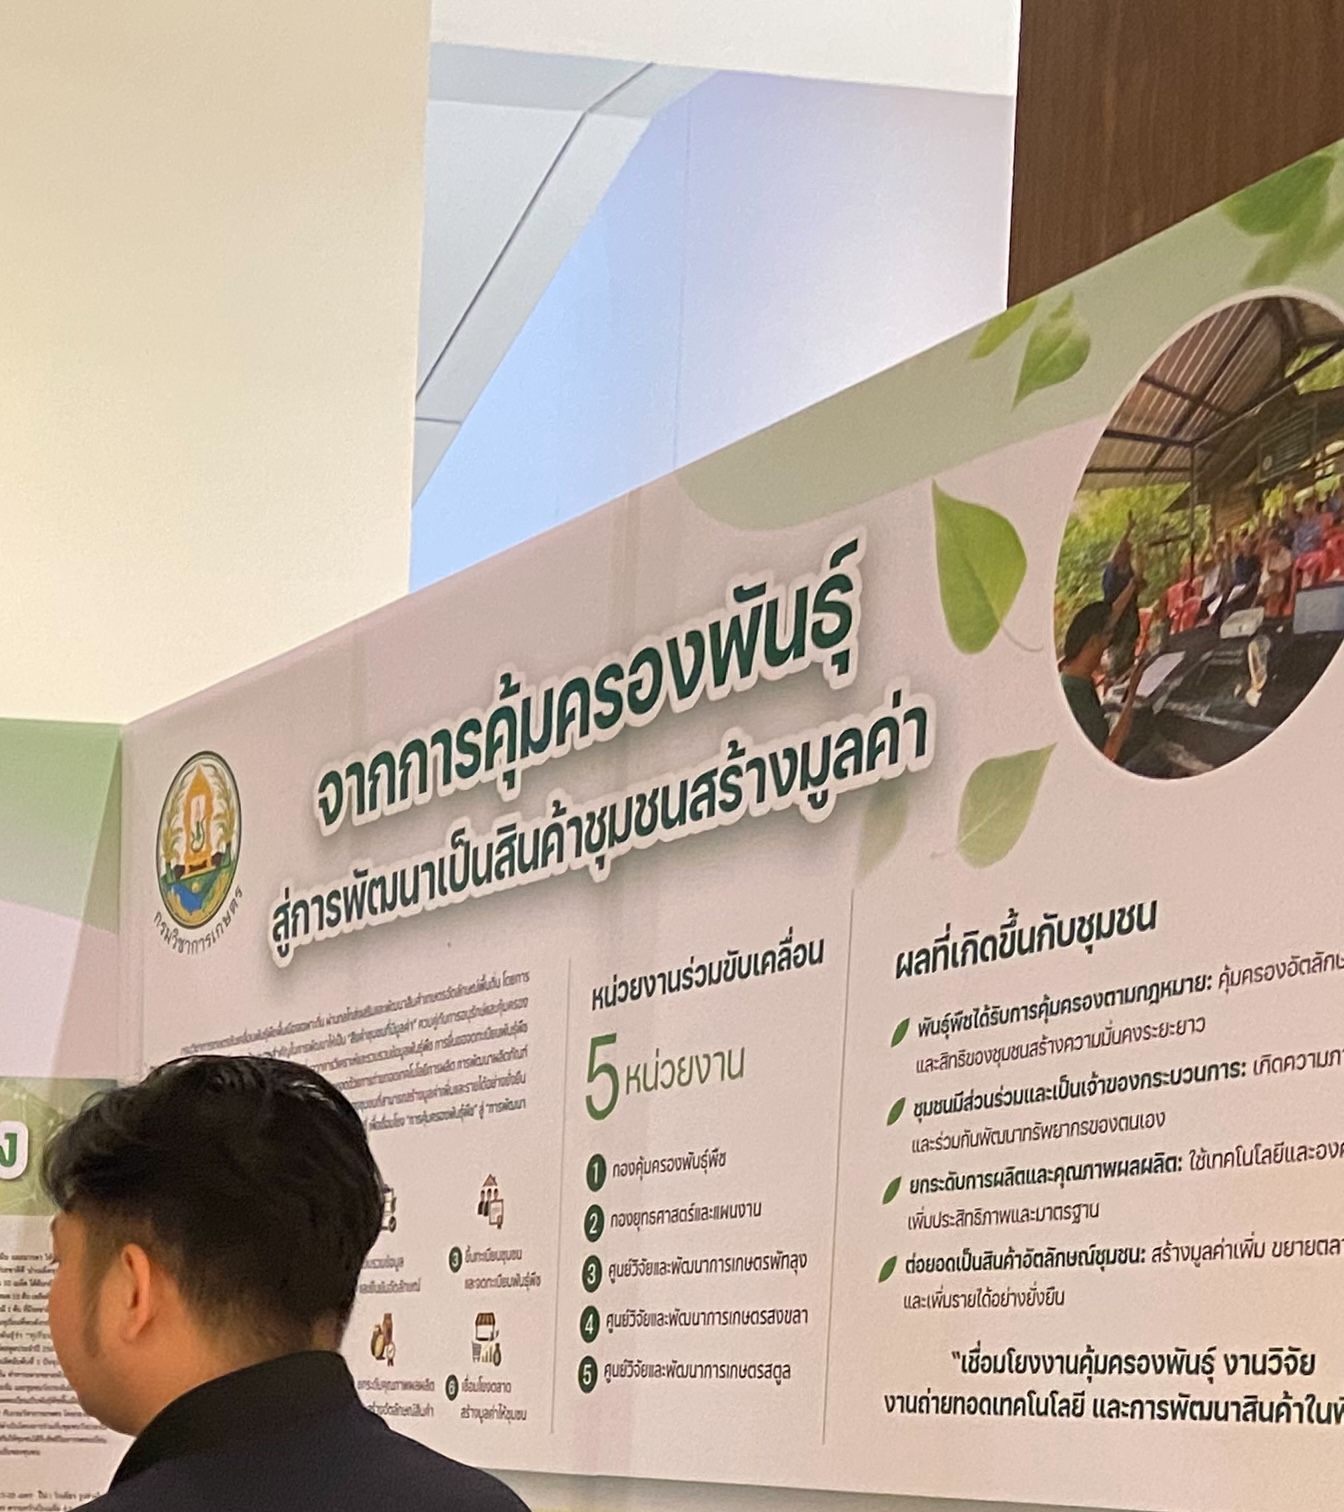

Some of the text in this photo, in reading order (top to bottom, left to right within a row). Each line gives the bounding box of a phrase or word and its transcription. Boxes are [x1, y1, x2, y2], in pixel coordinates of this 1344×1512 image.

[318, 538, 861, 828] จากการคุ้มครองพันธุ์
[271, 689, 930, 958] สู่การพัฒนาเป็นสินค้าชุมชนสร้างมูลค่า
[153, 886, 243, 955] กรมวิชาการเกษตร
[895, 900, 1158, 979] ผลที่เกิดขึ้นกับชุมชน
[592, 926, 825, 1011] หน่วยงานร่วมขับเคลื่อน
[918, 973, 1213, 1040] พันธุ์พืชได้รับการคุ้มครองตามกฎหมาย:
[916, 1016, 1206, 1074] และสิทธิของชุมชนสร้างความมั่นคงระยะยาว
[585, 1032, 745, 1121] 5 หน่วยงาน
[913, 1060, 1246, 1122] ชุมชนมีส่วนร่วมและเป็นเจ้าของกระบวนการ:
[912, 1110, 1166, 1153] และร่วมกันพัฒนาทรัพยากรของตนเอง
[612, 1150, 727, 1181] กองคุ้มครองพันธุ์พืช
[910, 1152, 1182, 1196] ยกระดับการผลิตและคุณภาพผลผลิต:
[610, 1200, 762, 1230] กองยุทธศาสตร์และแผนงาน
[908, 1201, 1099, 1231] เพิ่มประสิทธิภาพและมาตรฐาน
[608, 1253, 808, 1281] ศูนย์วิจัยและพัฒนาการเกษตรพัทลุง
[906, 1244, 1146, 1275] ต่อยอดเป็นสินค้าอัตลักษณ์ชุมชน:
[1151, 1231, 1266, 1268] สร้างมูลค่าเพิ่ม
[903, 1281, 1065, 1310] และเพิ่มรายได้อย่างยั่งยืน
[606, 1307, 809, 1333] ศูนย์วิจัยและพัฒนาการเกษตรสงขลา
[604, 1361, 791, 1384] ศูนย์วิจัยและพัฒนาการเกษตรสตูล
[952, 1340, 1316, 1384] “เชื่อมโยงงานคุ้มครองพันธุ์ งานวิจัย
[884, 1388, 1085, 1418] งานถ่ายทอดเทคโนโลยี
